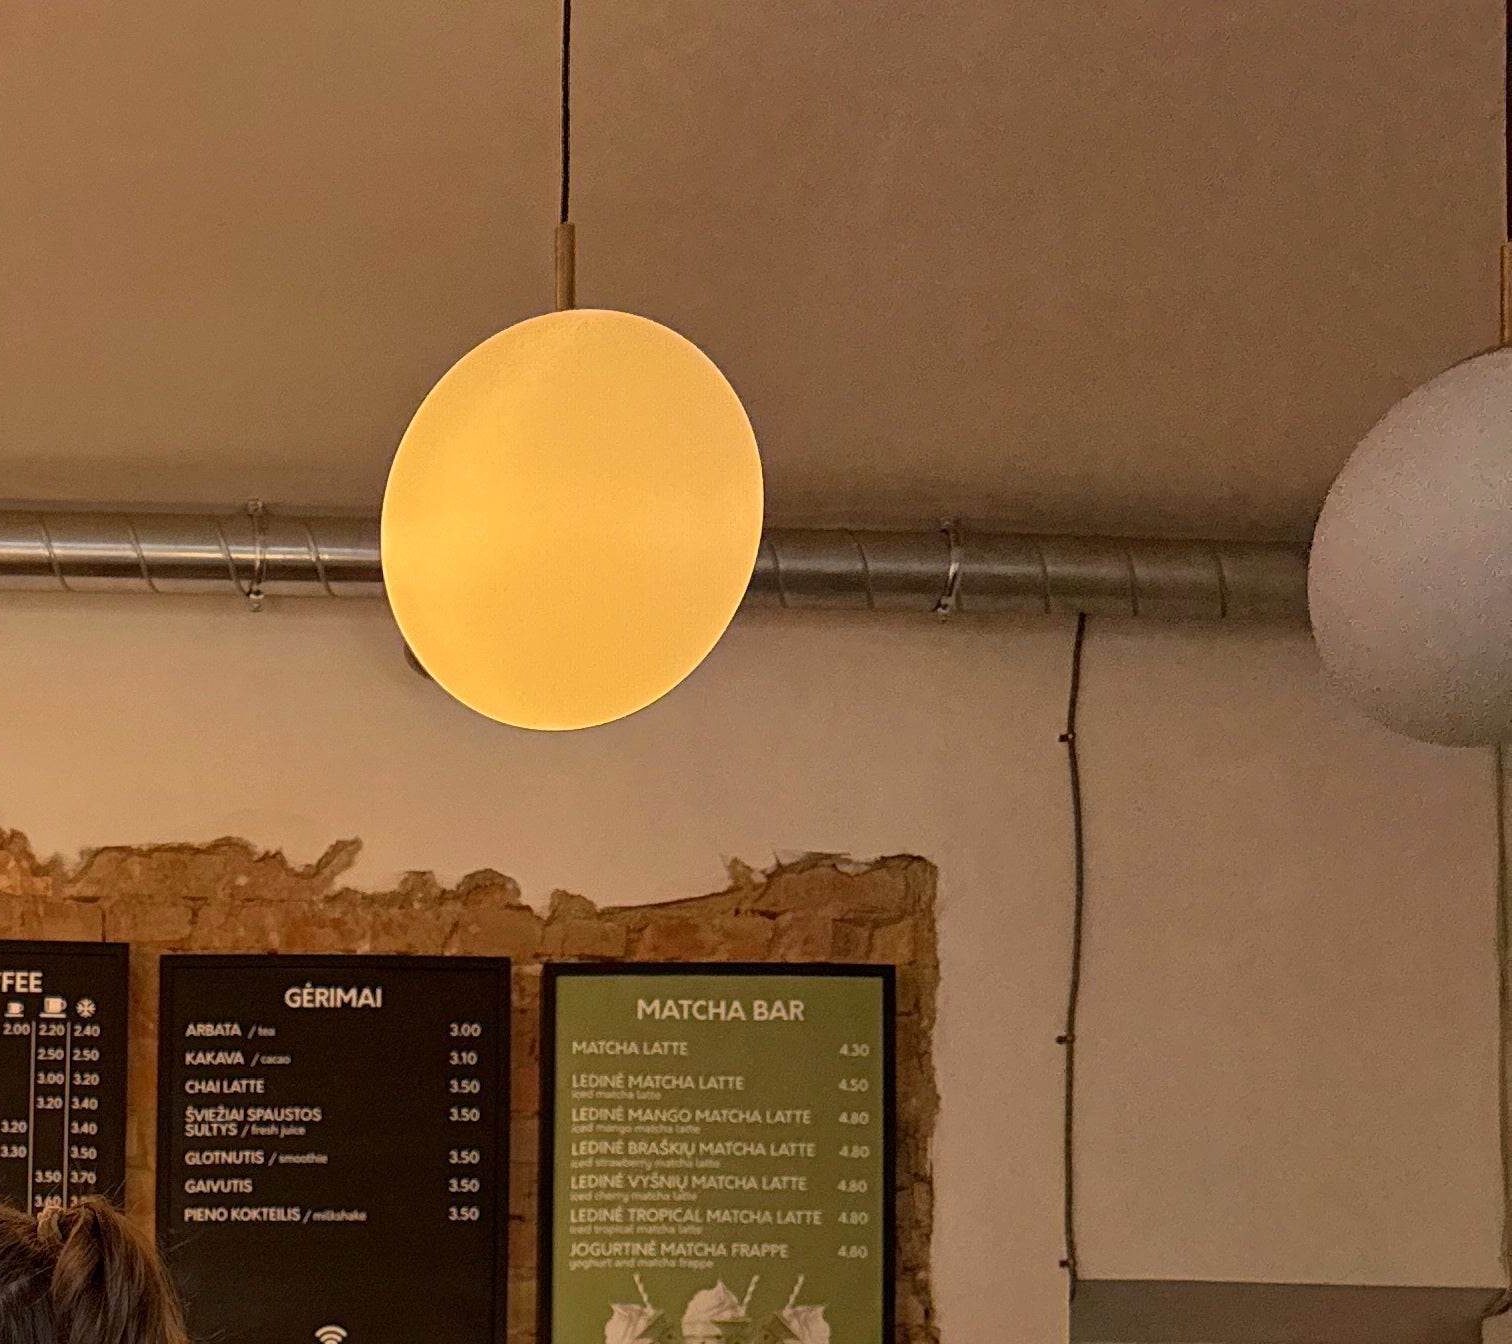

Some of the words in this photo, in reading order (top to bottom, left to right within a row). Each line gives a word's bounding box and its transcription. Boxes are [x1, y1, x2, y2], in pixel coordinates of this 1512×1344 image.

[285, 983, 383, 1008] GĖRIMAI
[638, 999, 746, 1021] MATCHA
[753, 1000, 804, 1022] BAR
[3, 1024, 30, 1035] 2.00
[39, 1024, 65, 1036] 2.20
[74, 1025, 100, 1037] 2.40
[185, 1024, 242, 1036] ARBATA
[449, 1024, 481, 1037] 3.00
[37, 1049, 64, 1060] 2.50
[72, 1049, 100, 1061] 2.50
[572, 1041, 638, 1054] MATCHA
[643, 1042, 688, 1056] LATTE
[185, 1051, 244, 1065] KAKAVA
[449, 1053, 478, 1065] 3.10
[37, 1072, 64, 1084] 3.00
[73, 1073, 100, 1085] 3.20
[628, 1076, 695, 1089] MATCHA
[699, 1077, 744, 1090] LATTE
[185, 1079, 220, 1094] CHAI
[223, 1078, 264, 1093] LATTE
[449, 1081, 480, 1093] 3.50
[36, 1097, 63, 1109] 3.20
[71, 1097, 98, 1110] 3.40
[185, 1106, 244, 1122] ŠVIEŽIAI
[247, 1108, 322, 1122] SPAUSTOS
[449, 1109, 480, 1122] 3.50
[628, 1109, 693, 1123] MANGO
[695, 1110, 762, 1124] MATCHA
[766, 1111, 811, 1124] LATTE
[0, 1121, 27, 1133] 3.20
[71, 1122, 97, 1135] 3.40
[185, 1123, 238, 1136] SULTYS
[0, 1146, 27, 1158] 3.30
[70, 1146, 97, 1159] 3.50
[699, 1143, 766, 1157] MATCHA
[770, 1143, 816, 1157] LATTE
[185, 1150, 264, 1165] GLOTNUTIS
[449, 1151, 480, 1164] 3.50
[35, 1171, 61, 1183] 3.50
[70, 1171, 96, 1184] 3.70
[692, 1177, 758, 1190] MATCHA
[762, 1177, 807, 1191] LATTE
[185, 1178, 252, 1193] GAIVUTIS
[448, 1179, 480, 1192] 3.50
[184, 1207, 228, 1221] PIENO
[231, 1206, 301, 1221] KOKTEILIS
[448, 1208, 480, 1221] 3.50
[628, 1210, 702, 1223] TROPICAL
[706, 1210, 773, 1224] MATCHA
[777, 1211, 822, 1224] LATTE
[661, 1243, 728, 1257] MATCHA
[731, 1245, 788, 1258] FRAPPE
